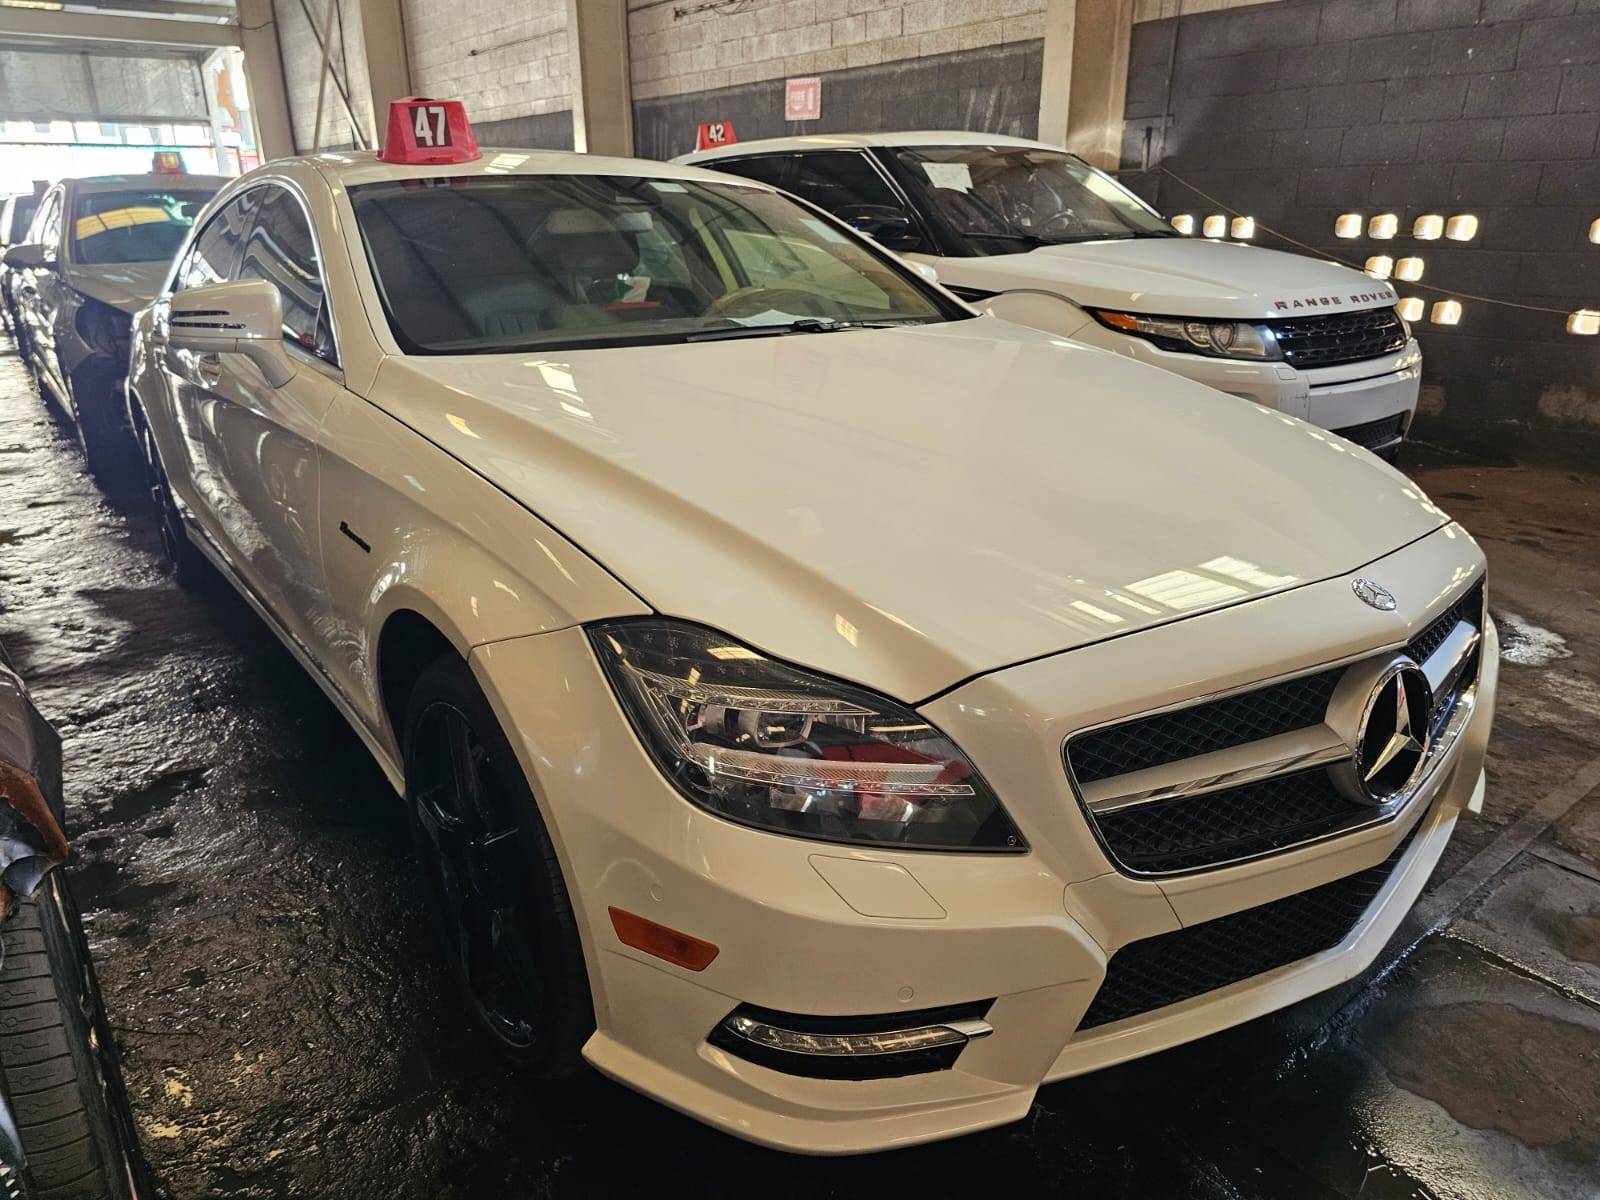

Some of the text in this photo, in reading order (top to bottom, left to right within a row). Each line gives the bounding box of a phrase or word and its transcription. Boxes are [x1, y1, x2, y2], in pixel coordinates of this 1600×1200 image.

[415, 106, 446, 146] 47
[709, 124, 726, 142] 42
[1274, 291, 1393, 311] RANGE ROVER
